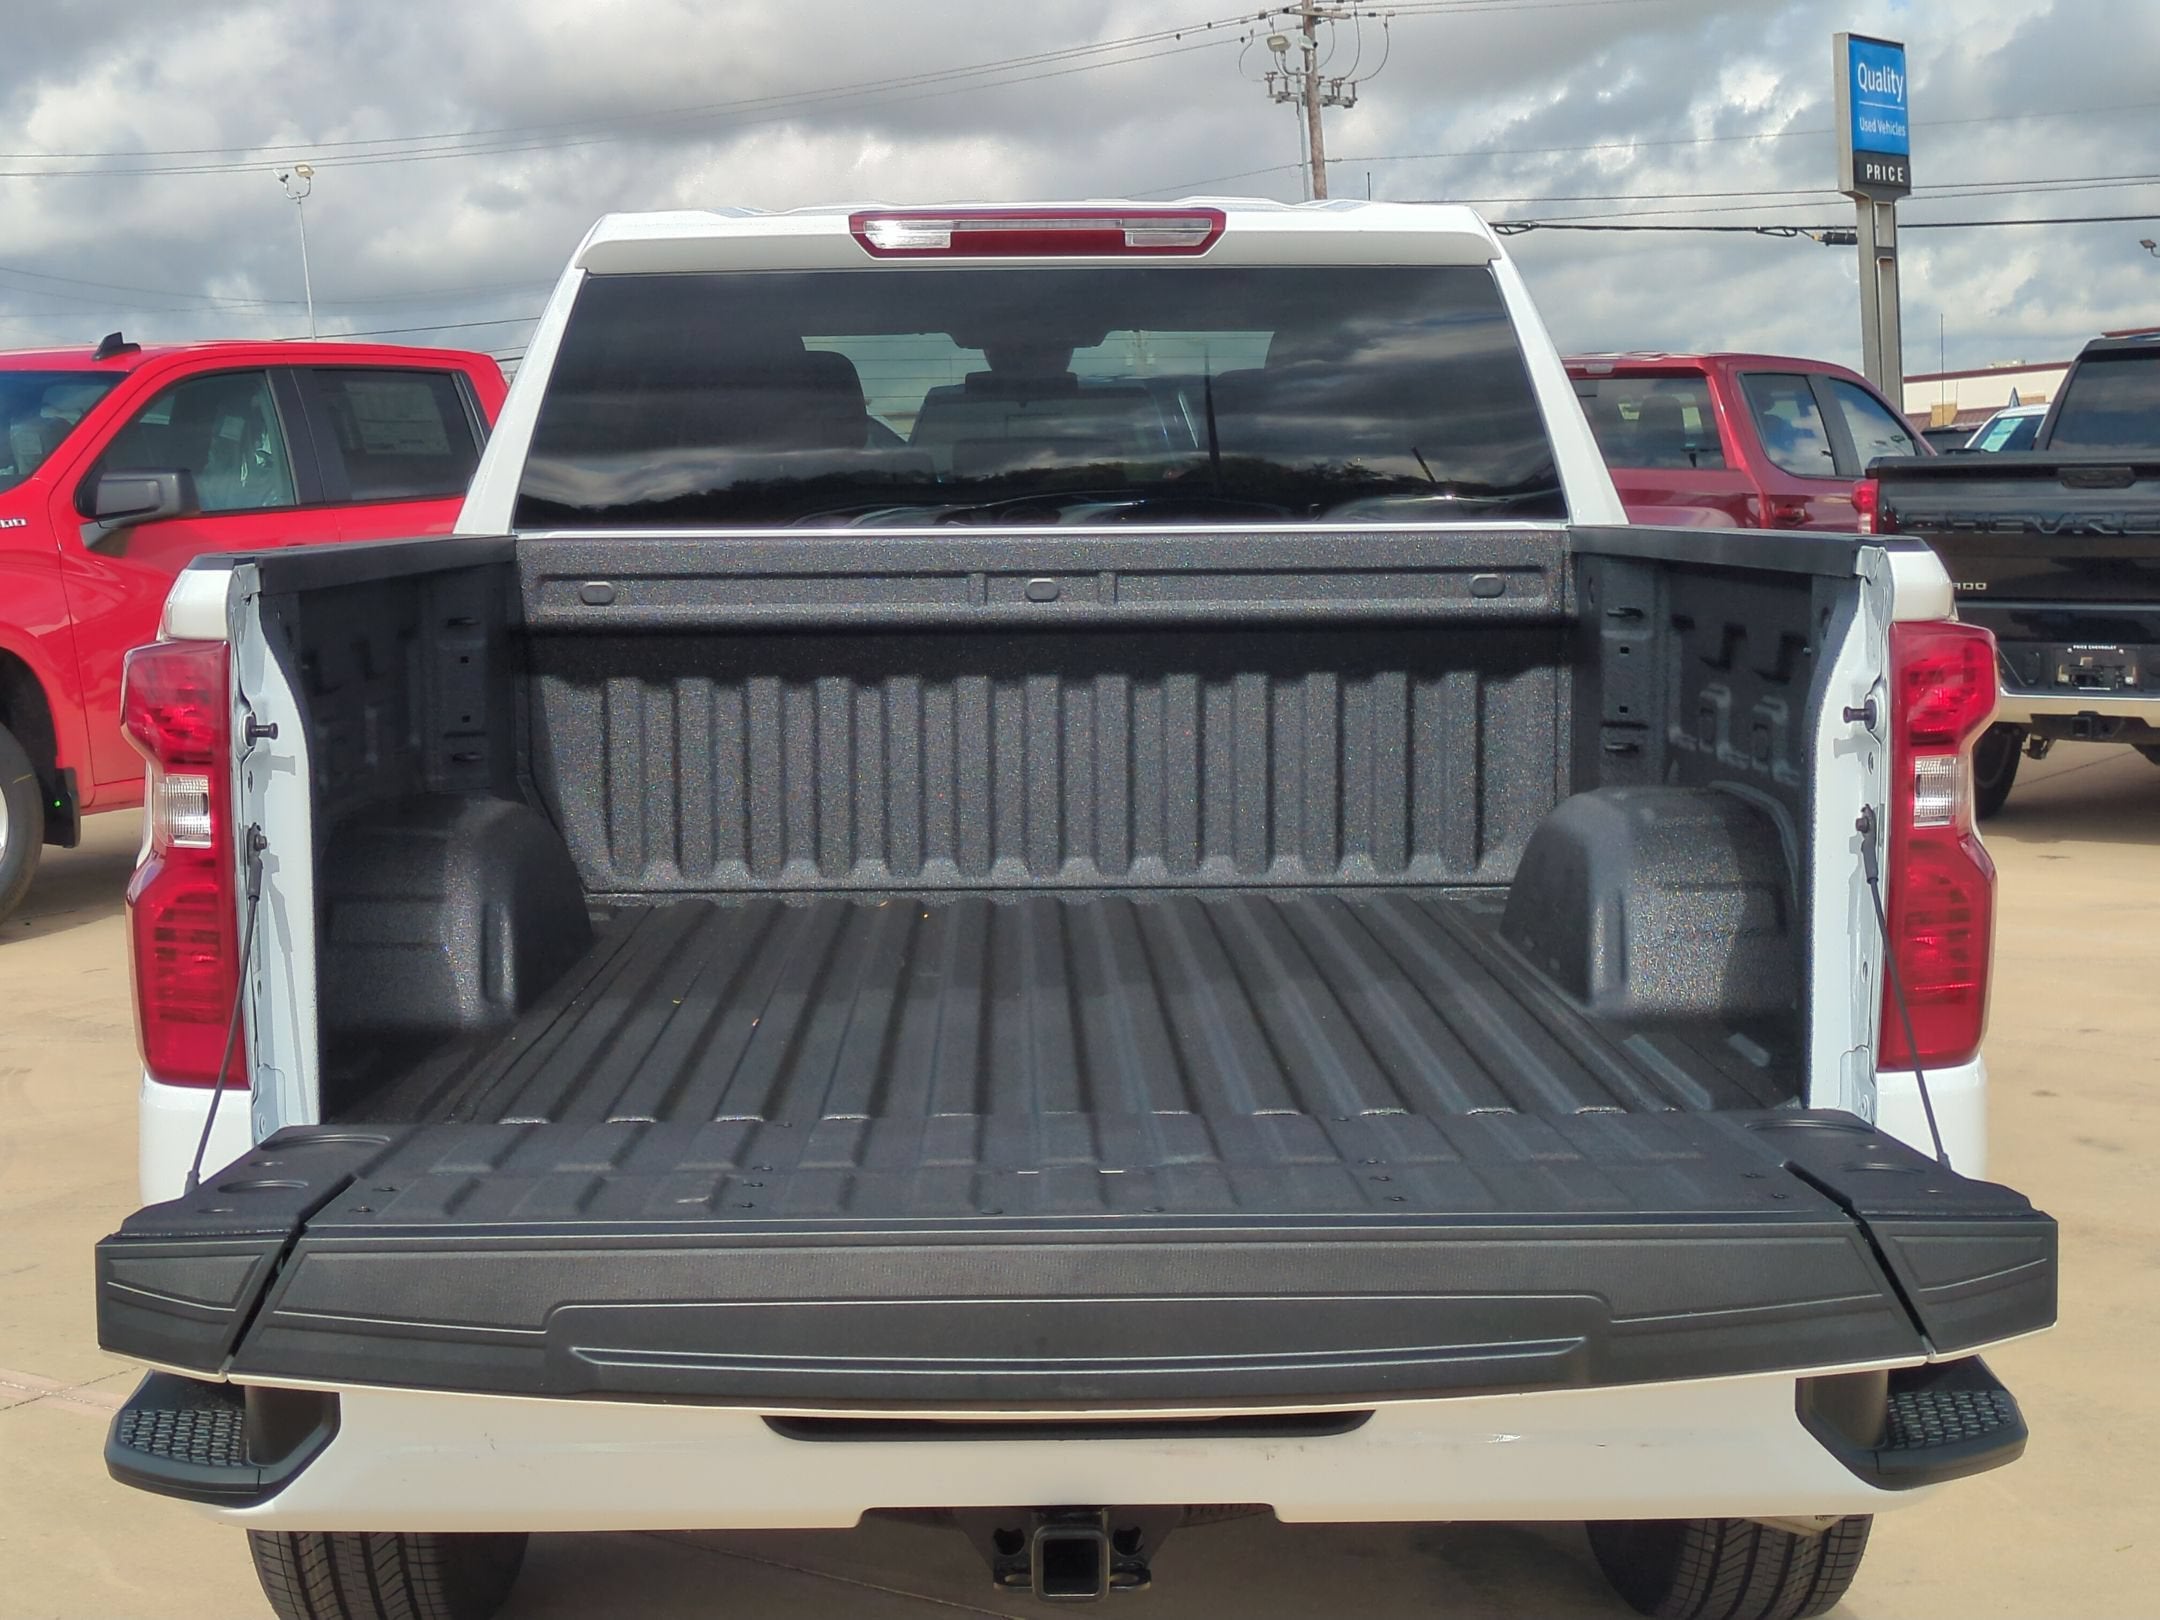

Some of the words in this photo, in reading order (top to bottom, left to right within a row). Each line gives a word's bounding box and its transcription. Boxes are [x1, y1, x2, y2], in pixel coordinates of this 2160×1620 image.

[1857, 62, 1904, 102] Quality
[1860, 117, 1876, 133] Used
[1877, 119, 1906, 137] Vehicles
[1866, 163, 1904, 182] PRICE
